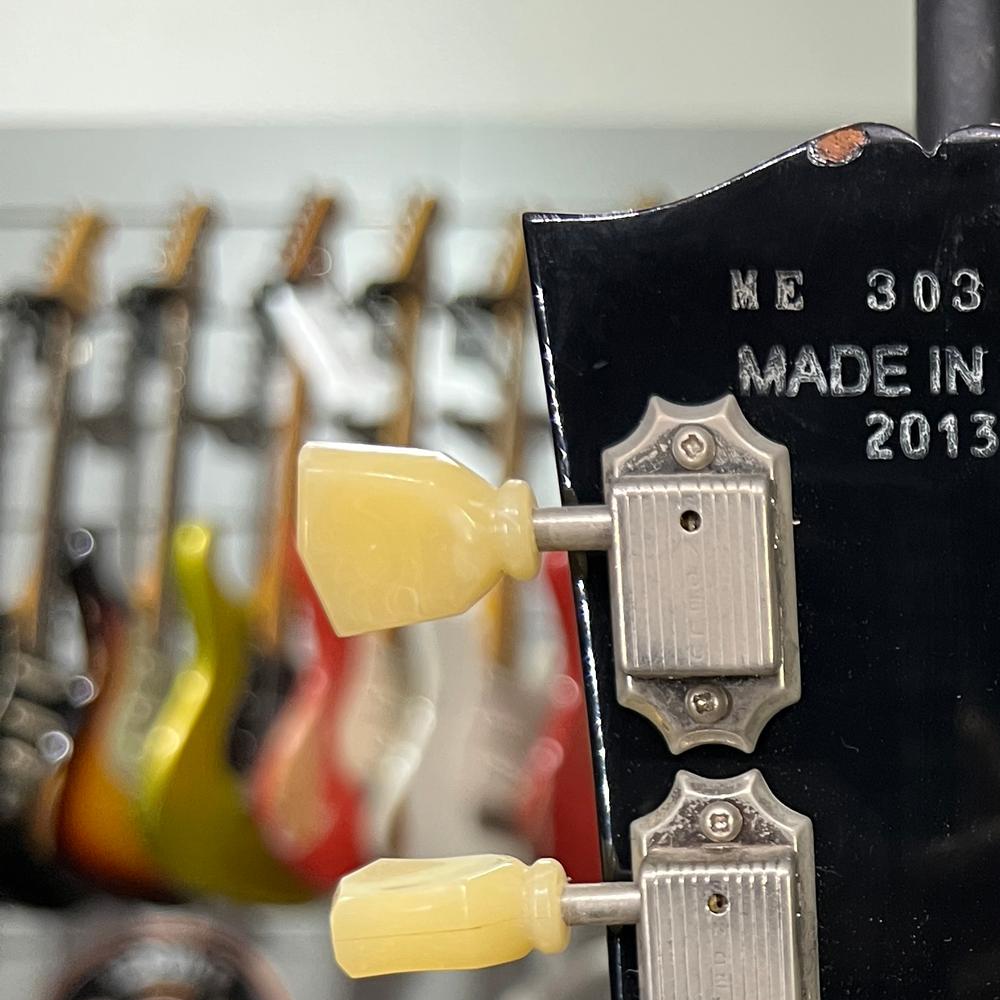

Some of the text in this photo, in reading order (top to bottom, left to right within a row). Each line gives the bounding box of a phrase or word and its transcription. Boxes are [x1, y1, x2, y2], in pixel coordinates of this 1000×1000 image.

[737, 343, 912, 398] MADE
[928, 343, 986, 396] IN
[865, 410, 999, 460] 2013
